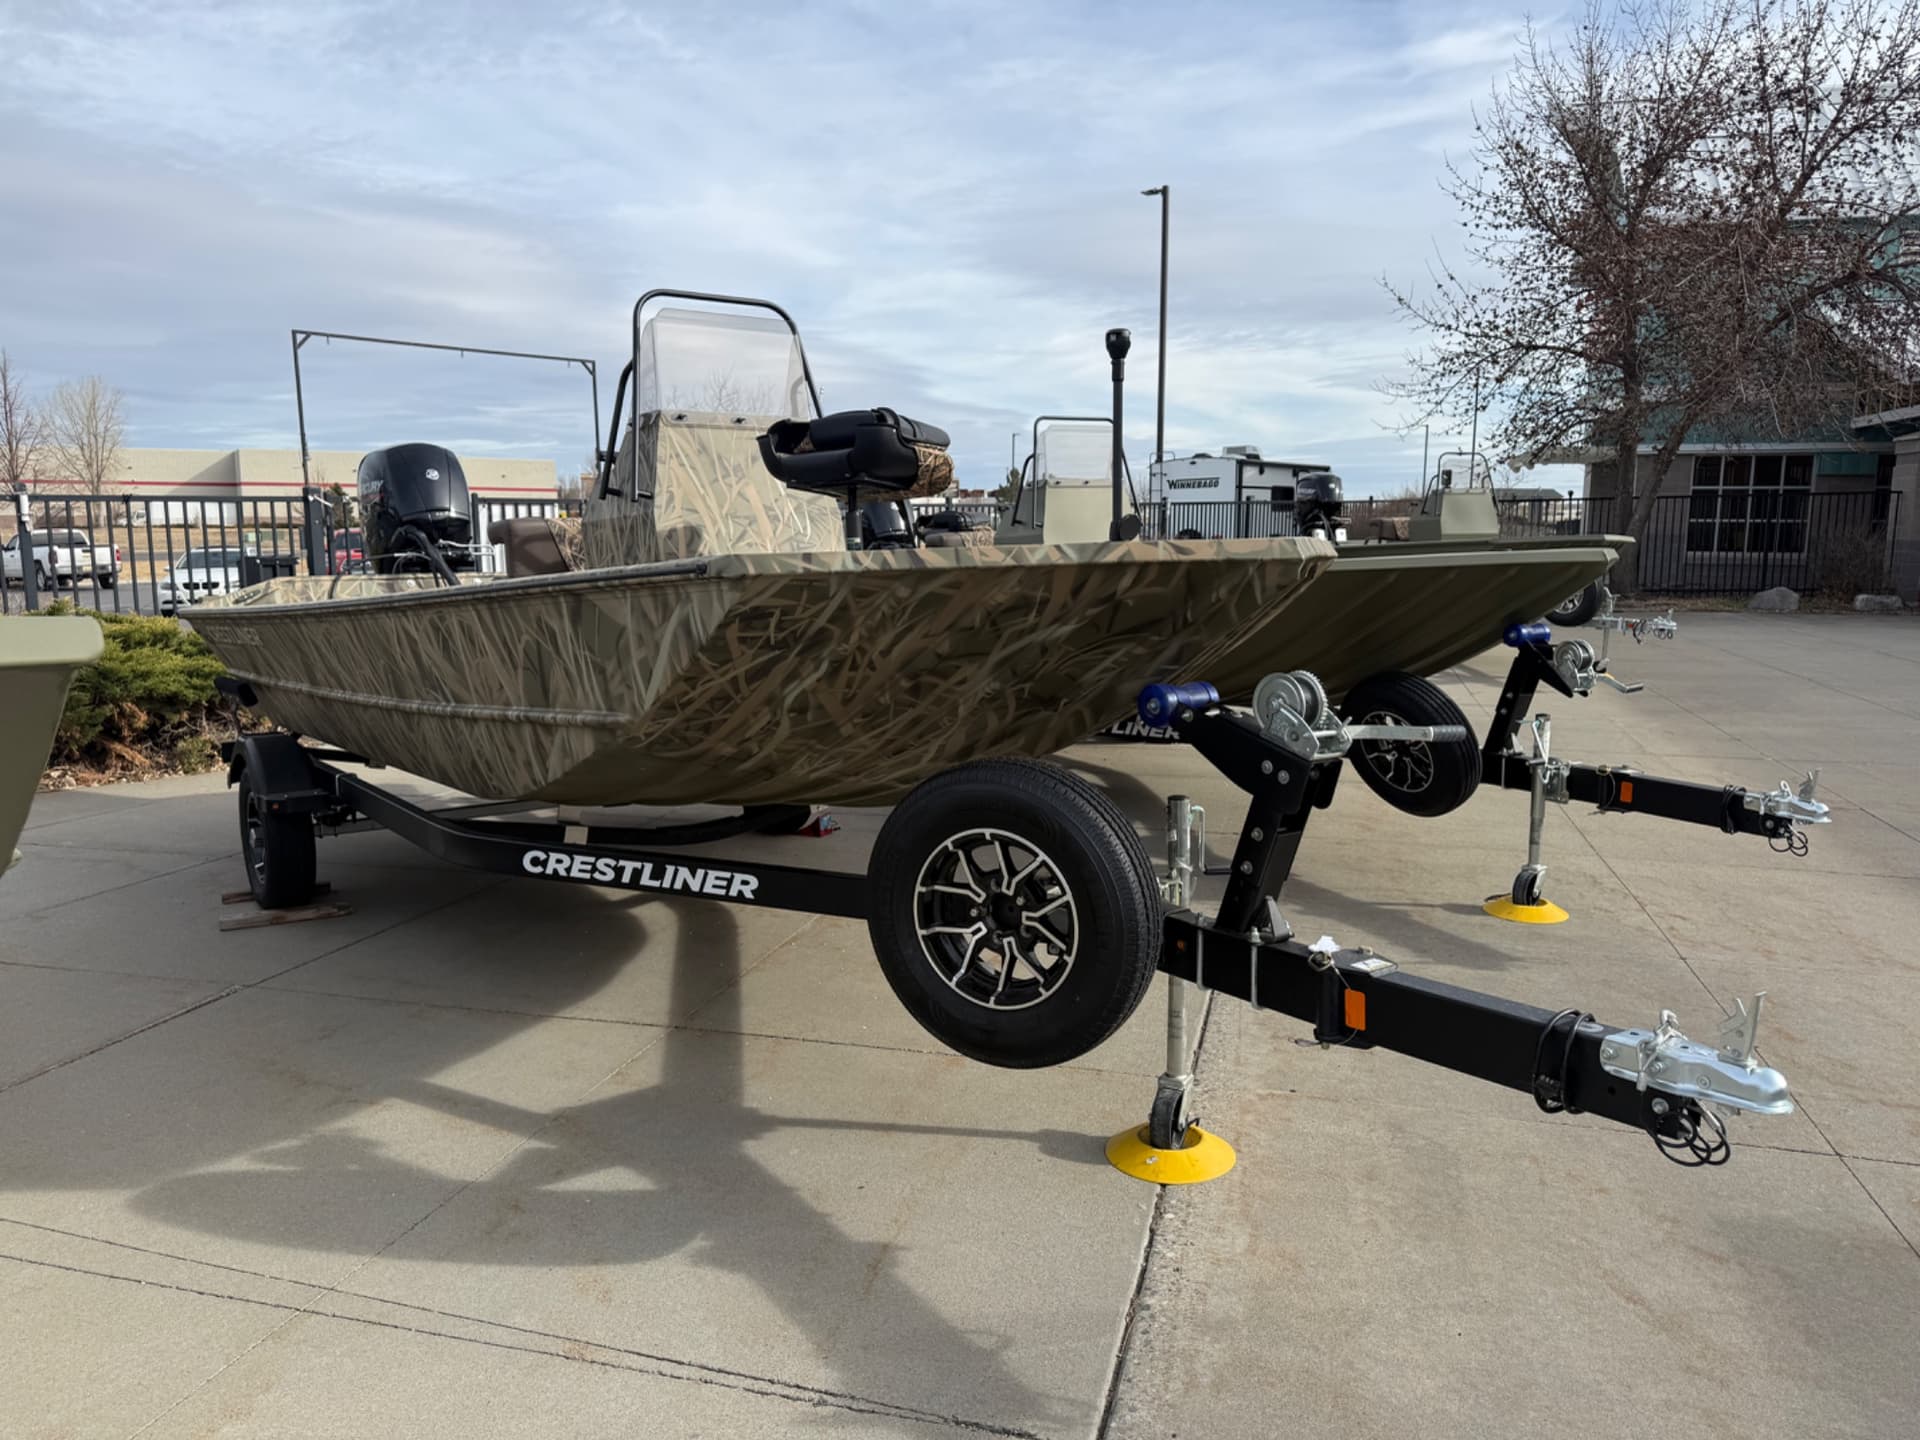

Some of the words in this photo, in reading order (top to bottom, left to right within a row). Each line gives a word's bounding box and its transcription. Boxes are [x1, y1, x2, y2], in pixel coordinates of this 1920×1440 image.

[1166, 477, 1220, 490] WINNEBAGO
[1109, 718, 1180, 739] LINER
[522, 850, 759, 899] CRESTLINER
